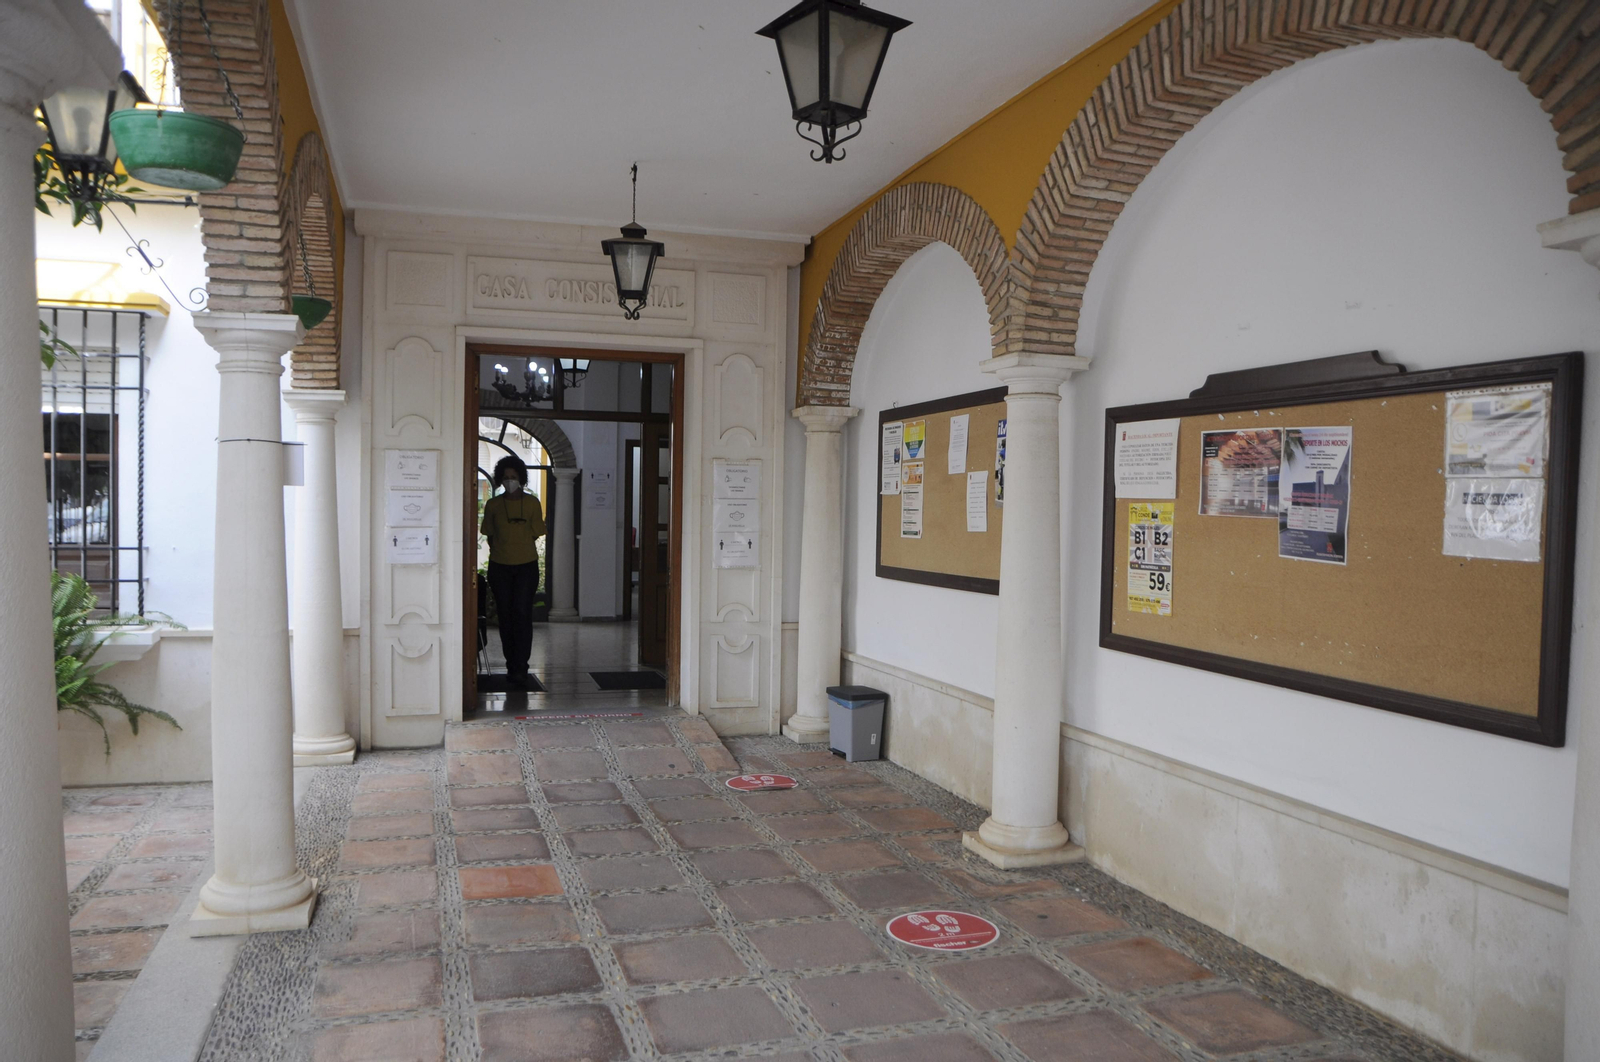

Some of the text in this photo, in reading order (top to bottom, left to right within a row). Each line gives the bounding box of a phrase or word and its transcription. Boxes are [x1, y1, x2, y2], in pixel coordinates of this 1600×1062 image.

[476, 273, 532, 300] CASA
[1134, 531, 1168, 546] B1 B2
[1134, 546, 1146, 560] C1
